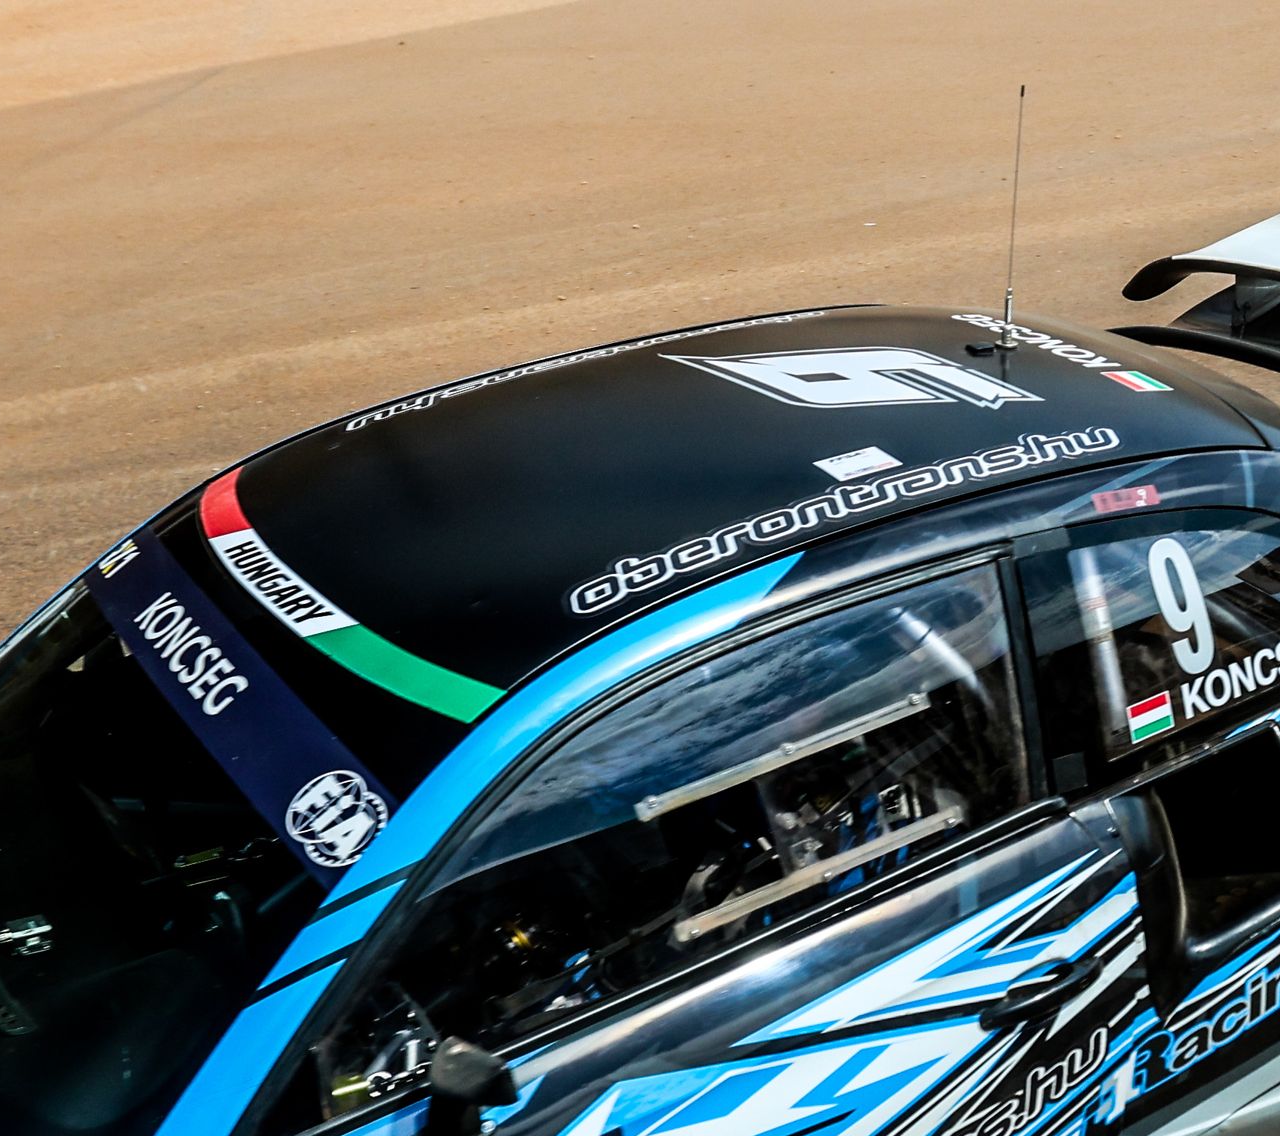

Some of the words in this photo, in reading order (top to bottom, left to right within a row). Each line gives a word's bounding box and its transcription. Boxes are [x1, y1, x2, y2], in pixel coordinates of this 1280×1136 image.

[223, 540, 334, 624] HUNGARY
[568, 425, 1121, 614] oberontrans.hu
[133, 591, 249, 716] KONCSEG
[1148, 537, 1215, 675] 9
